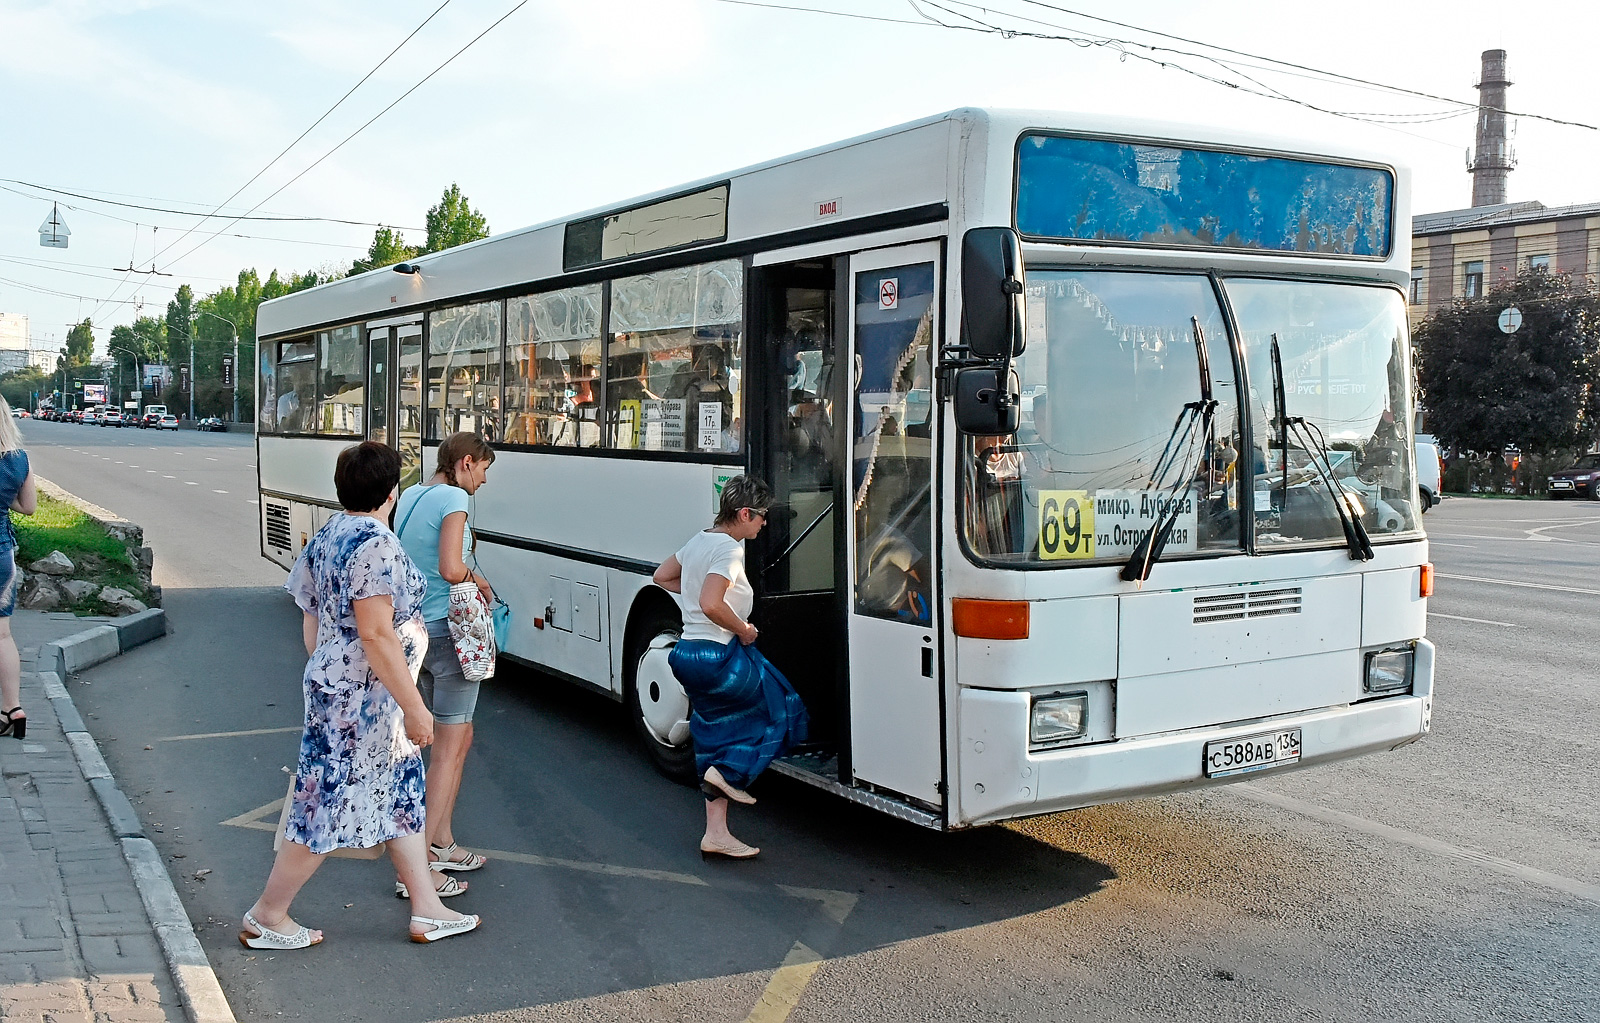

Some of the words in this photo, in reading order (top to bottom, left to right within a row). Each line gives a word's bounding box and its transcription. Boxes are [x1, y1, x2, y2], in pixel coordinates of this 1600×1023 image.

[819, 201, 837, 216] ВХОД
[1097, 497, 1135, 519] микр.
[1139, 493, 1192, 519] Дубрава
[1097, 533, 1113, 546] ул.
[1276, 732, 1298, 751] 136
[1280, 749, 1292, 758] RUS
